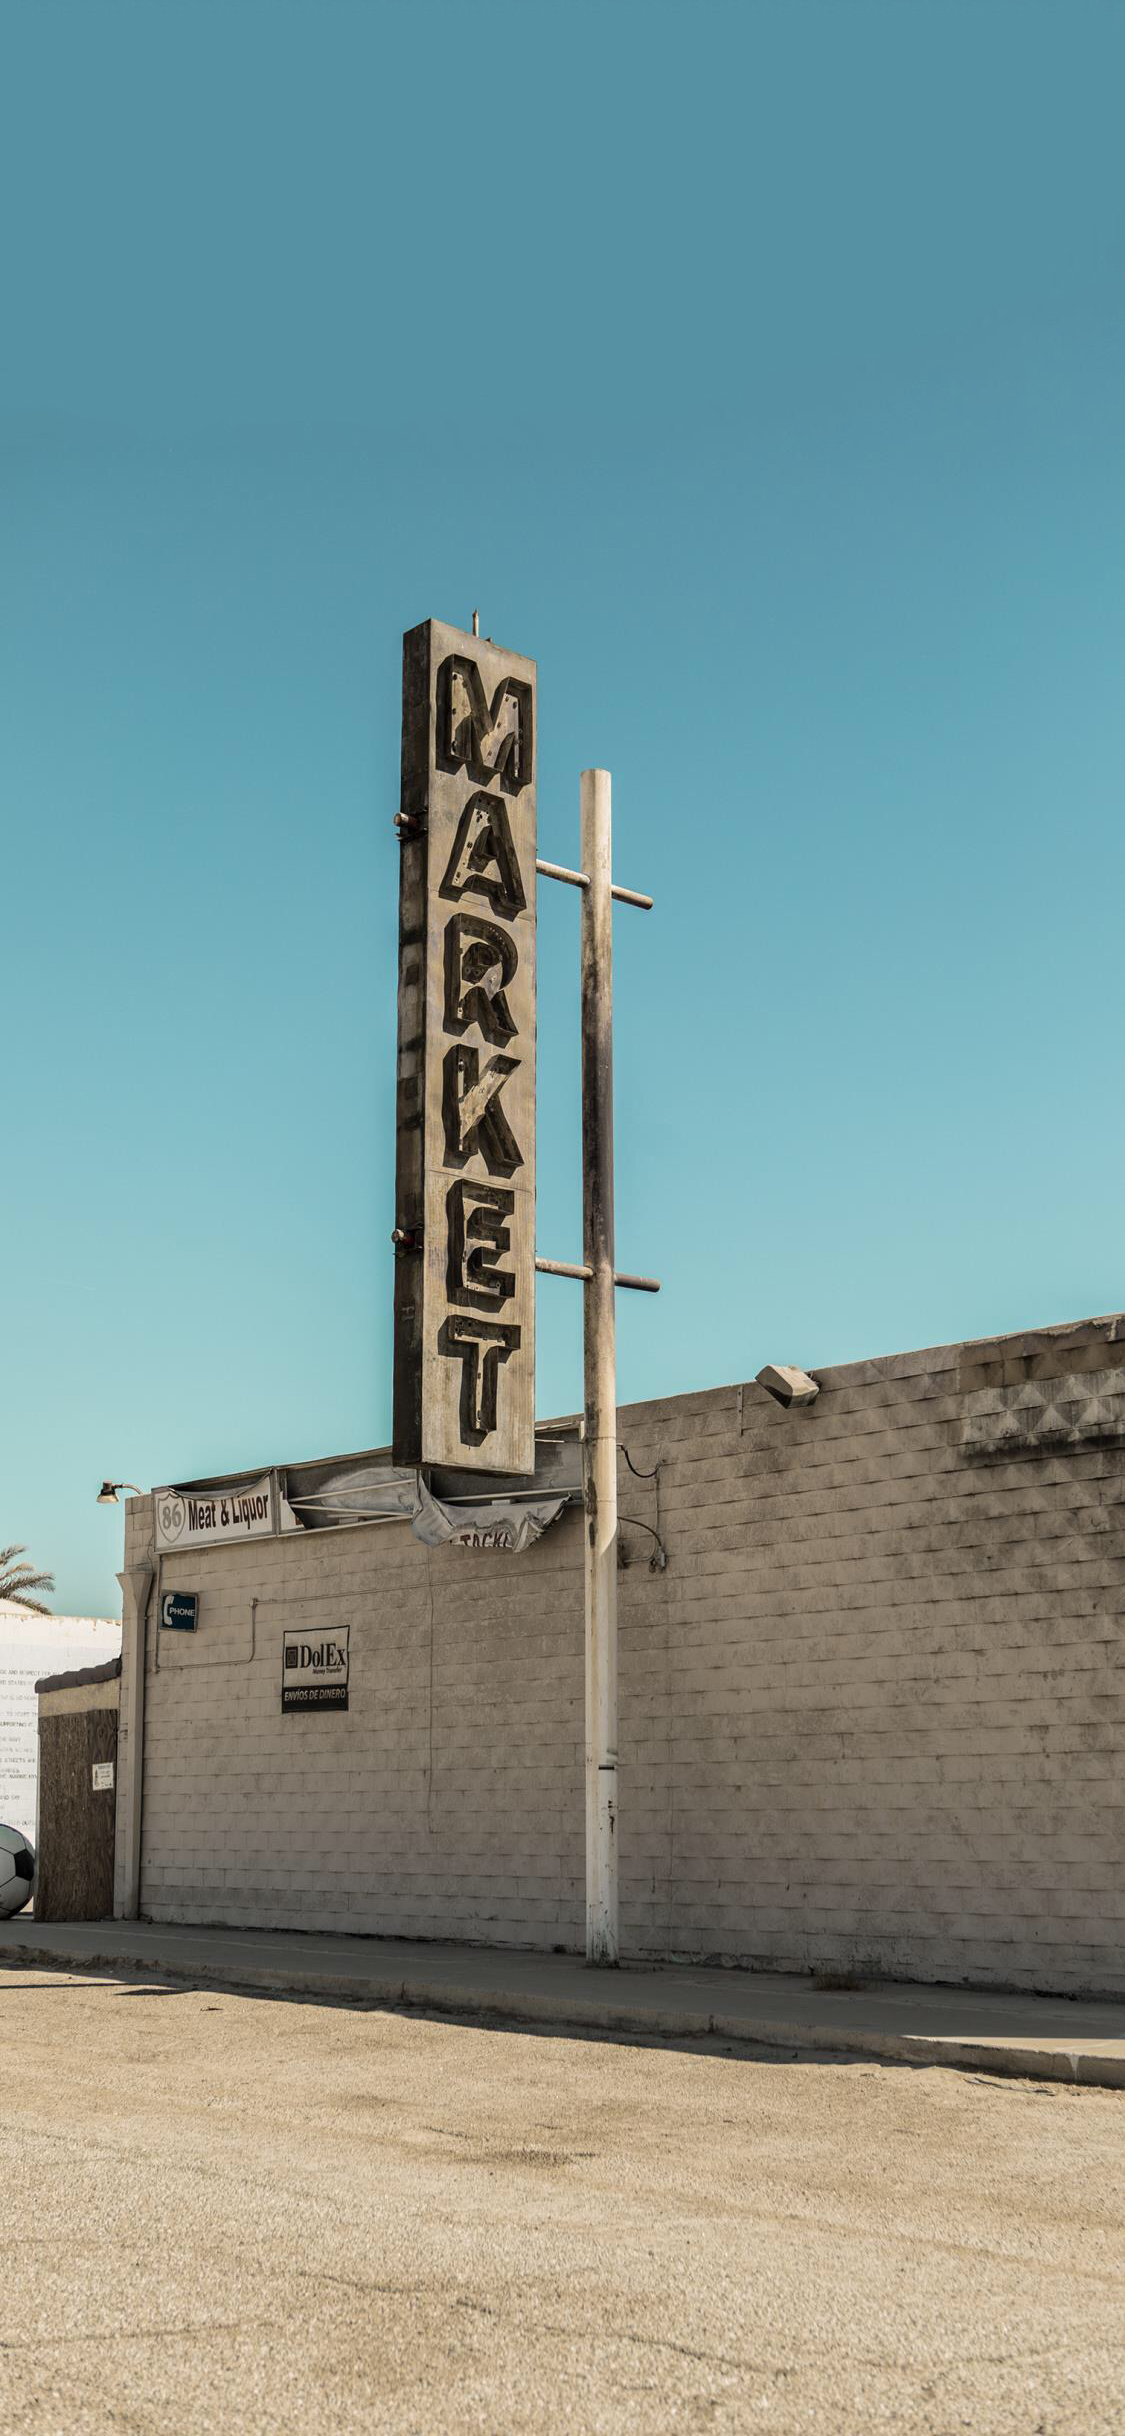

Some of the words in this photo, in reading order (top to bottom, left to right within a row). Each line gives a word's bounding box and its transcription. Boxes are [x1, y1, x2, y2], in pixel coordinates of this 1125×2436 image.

[436, 654, 532, 1447] MARKET
[162, 1502, 182, 1530] 86
[187, 1500, 217, 1531] Meat
[220, 1499, 230, 1527] &
[231, 1495, 269, 1530] Liquor
[169, 1607, 196, 1617] PHONE
[300, 1643, 347, 1668] DolEx
[284, 1689, 309, 1702] ENVÍOS
[309, 1689, 319, 1700] DE
[319, 1688, 346, 1700] DINERO
